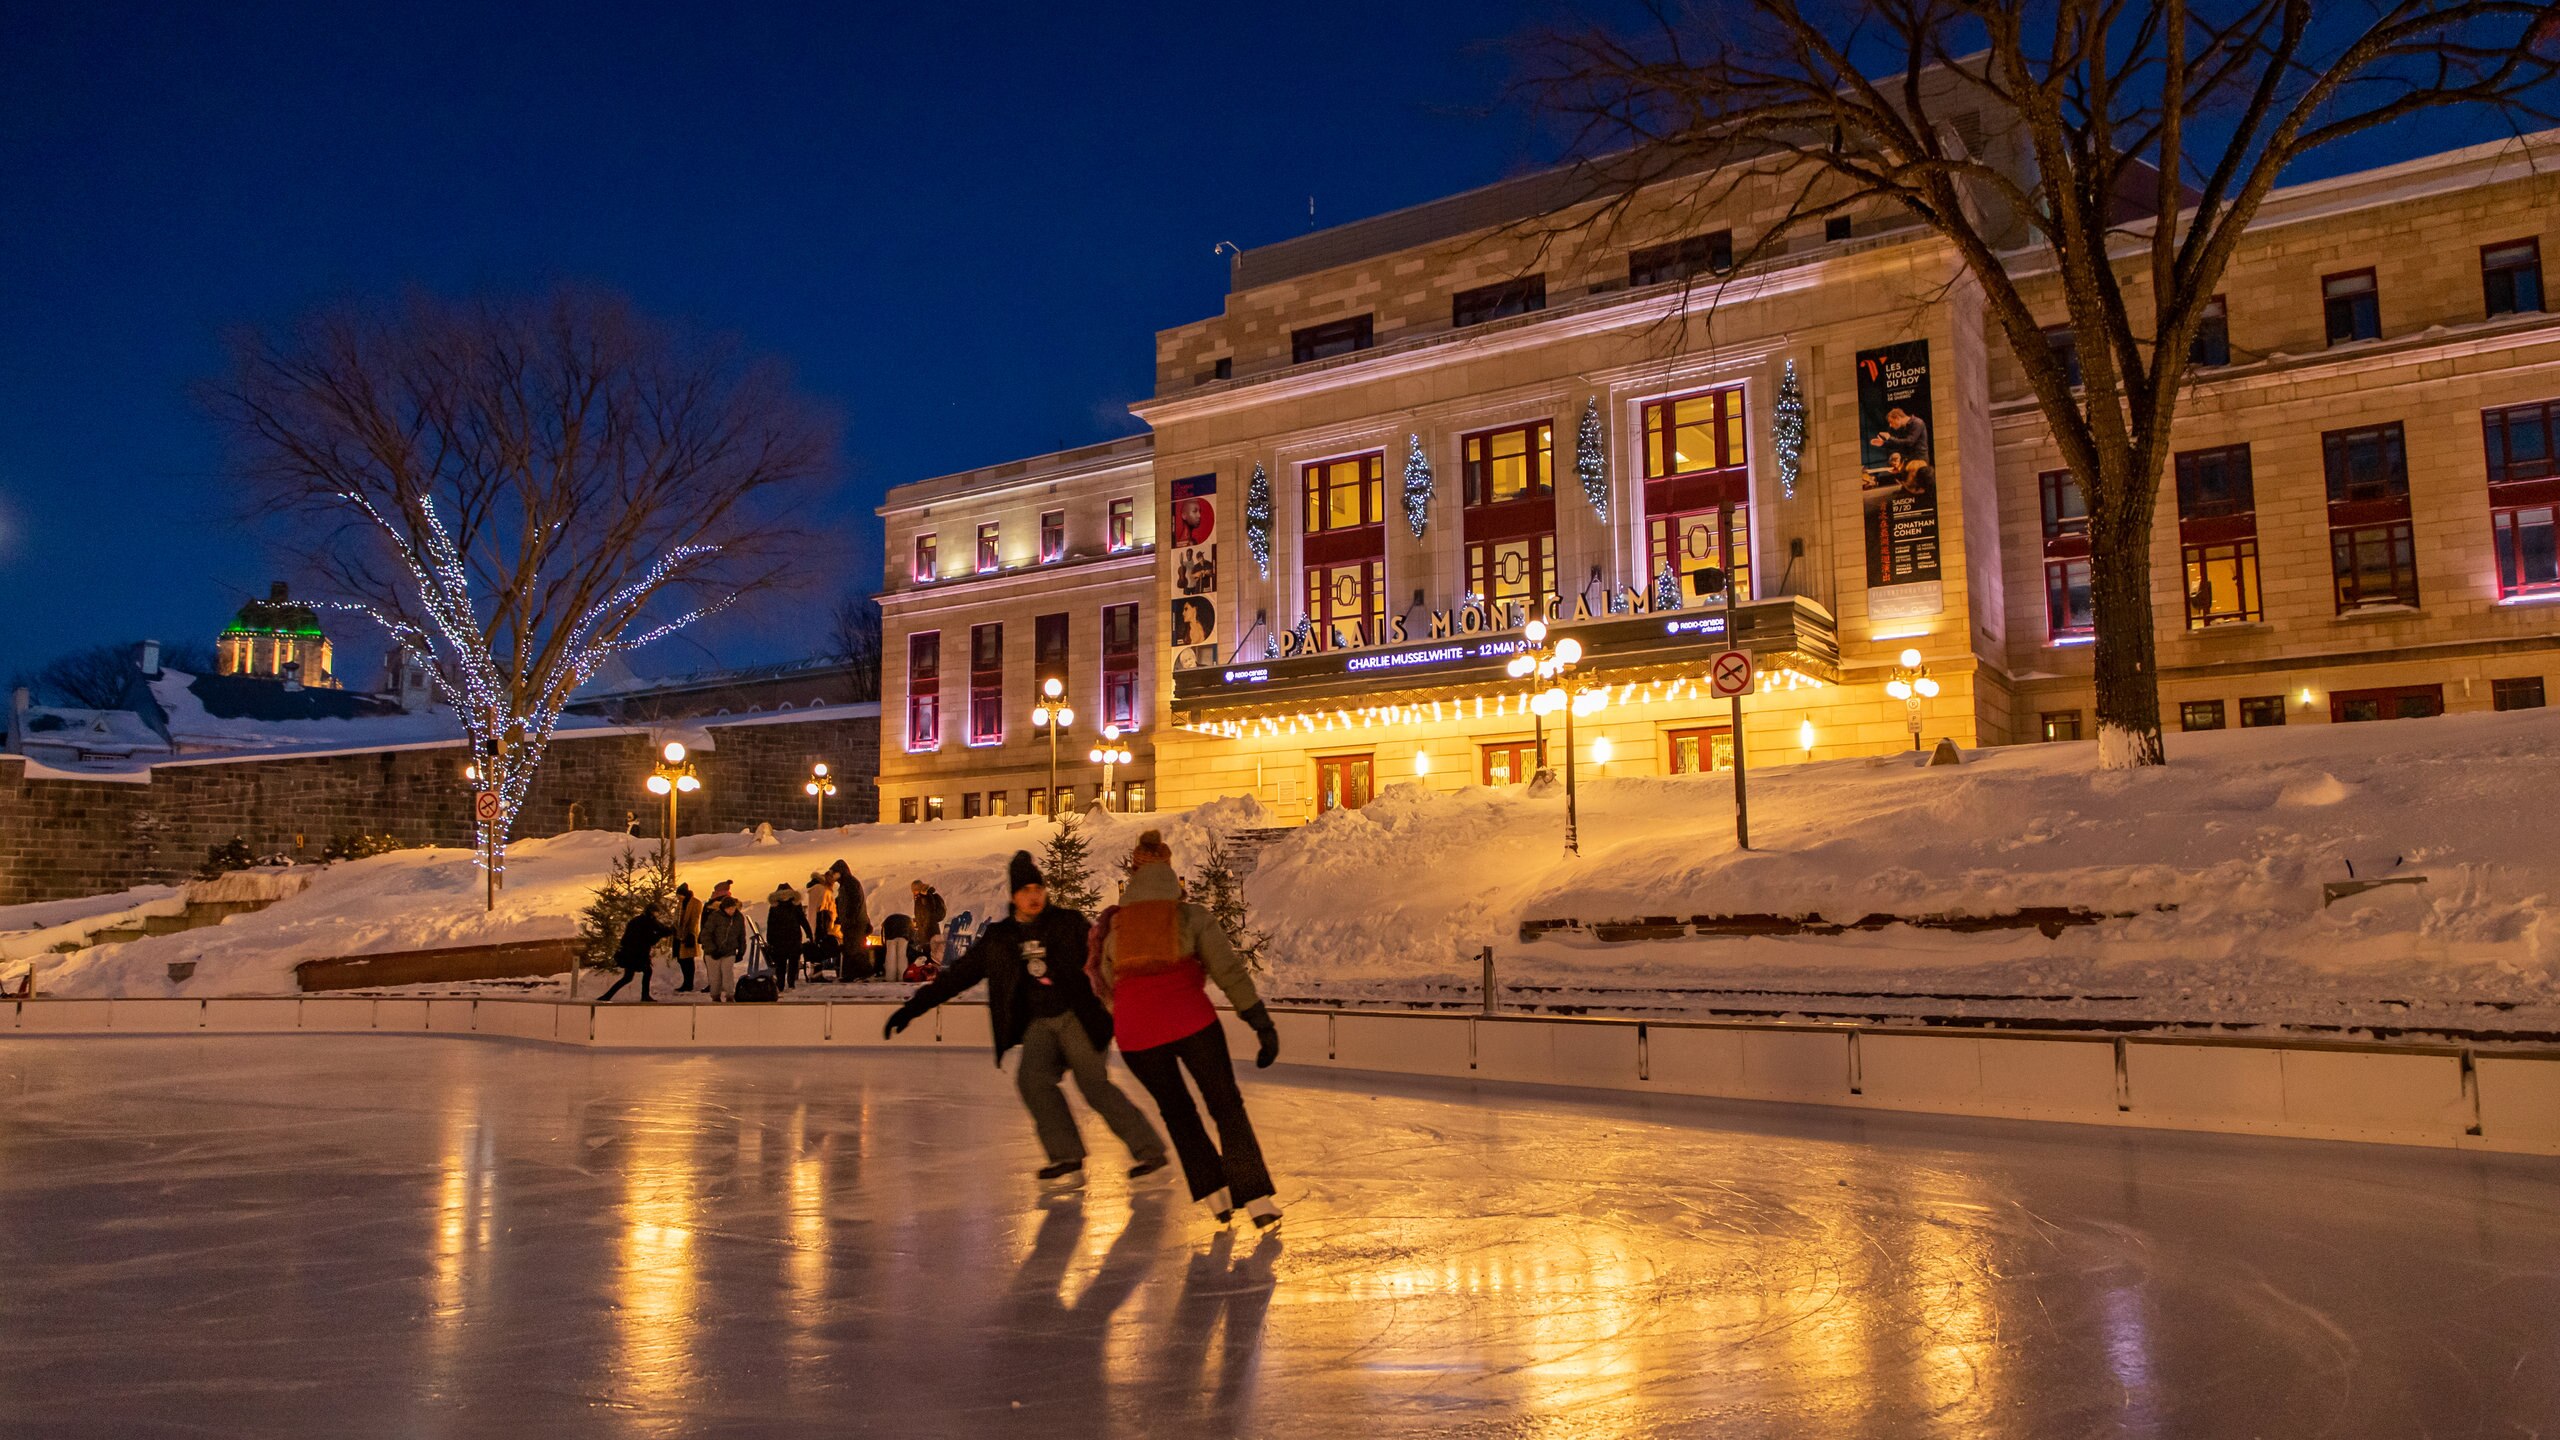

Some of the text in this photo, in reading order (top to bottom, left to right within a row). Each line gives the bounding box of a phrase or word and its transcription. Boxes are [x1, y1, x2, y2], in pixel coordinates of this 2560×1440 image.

[1886, 362, 1901, 372] LES
[1886, 366, 1926, 379] VIOLONS
[1886, 375, 1919, 388] DU ROY
[1892, 497, 1915, 505] SAISON
[1893, 519, 1935, 530] JONATHAN
[1893, 528, 1922, 537] COHEN
[1280, 585, 1650, 657] PALAIS MONTCALM
[1348, 655, 1390, 670] CHARLIE
[1391, 647, 1464, 666] MUSSELWHITE
[1479, 644, 1492, 656] 12
[1493, 641, 1514, 654] MAI
